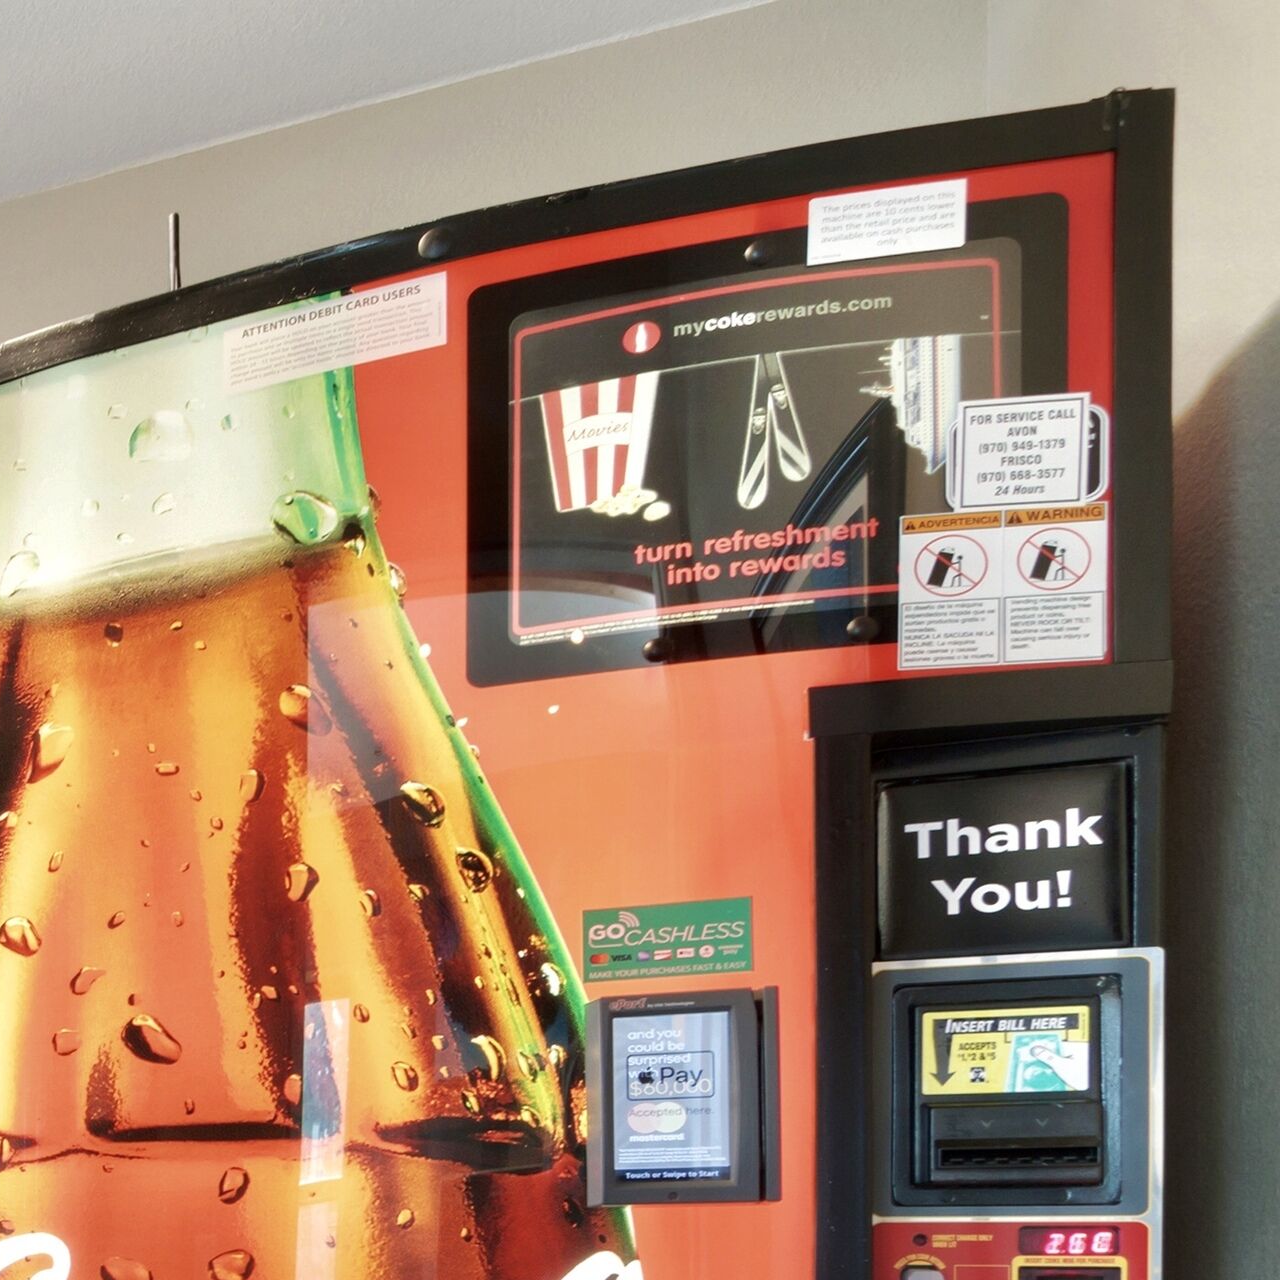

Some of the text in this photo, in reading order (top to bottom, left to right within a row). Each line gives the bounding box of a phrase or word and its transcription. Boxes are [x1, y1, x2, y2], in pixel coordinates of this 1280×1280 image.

[822, 205, 840, 214] The
[842, 201, 871, 213] prices
[873, 195, 921, 209] displayed
[937, 190, 956, 199] this
[822, 201, 956, 223] machine are 10 cents lower
[821, 211, 956, 234] than the retail price and are
[821, 221, 955, 243] available on cash purchases
[877, 238, 898, 246] only
[241, 284, 421, 339] ATTENTION DEBIT CARD USERS
[673, 295, 893, 338] mycokerewards.com
[970, 408, 1077, 426] FOR SERVICE CALL
[566, 420, 630, 443] Movies
[1006, 426, 1038, 438] AVON
[978, 438, 1067, 455] (970) 949-1379
[1000, 454, 1043, 467] FRISCO
[976, 467, 1066, 484] (970) 668-3577
[994, 483, 1046, 497] 24 Hours
[918, 515, 1000, 529] ADVERTENCIA
[1025, 506, 1103, 523] WARNING
[634, 517, 878, 564] turn refreshment
[667, 546, 846, 586] into rewards
[904, 807, 1104, 860] Thank
[930, 869, 1073, 916] You!
[589, 923, 626, 941] GO
[624, 921, 746, 947] CASHLESS
[611, 954, 633, 962] VISA
[589, 961, 747, 979] MAKE YOUR PURCHASES FAST EASY
[944, 1016, 1068, 1034] INSERT BILL HERE
[627, 1029, 682, 1041] and you
[627, 1041, 685, 1053] could be
[958, 1041, 997, 1051] ACCEPTS
[628, 1053, 691, 1068] surprised
[978, 1053, 987, 1061] &
[660, 1066, 704, 1088] Pay
[629, 1105, 682, 1118] Accepted
[625, 1171, 650, 1180] Touch
[662, 1171, 686, 1181] Swipe
[688, 1170, 697, 1178] to
[698, 1169, 720, 1178] Start
